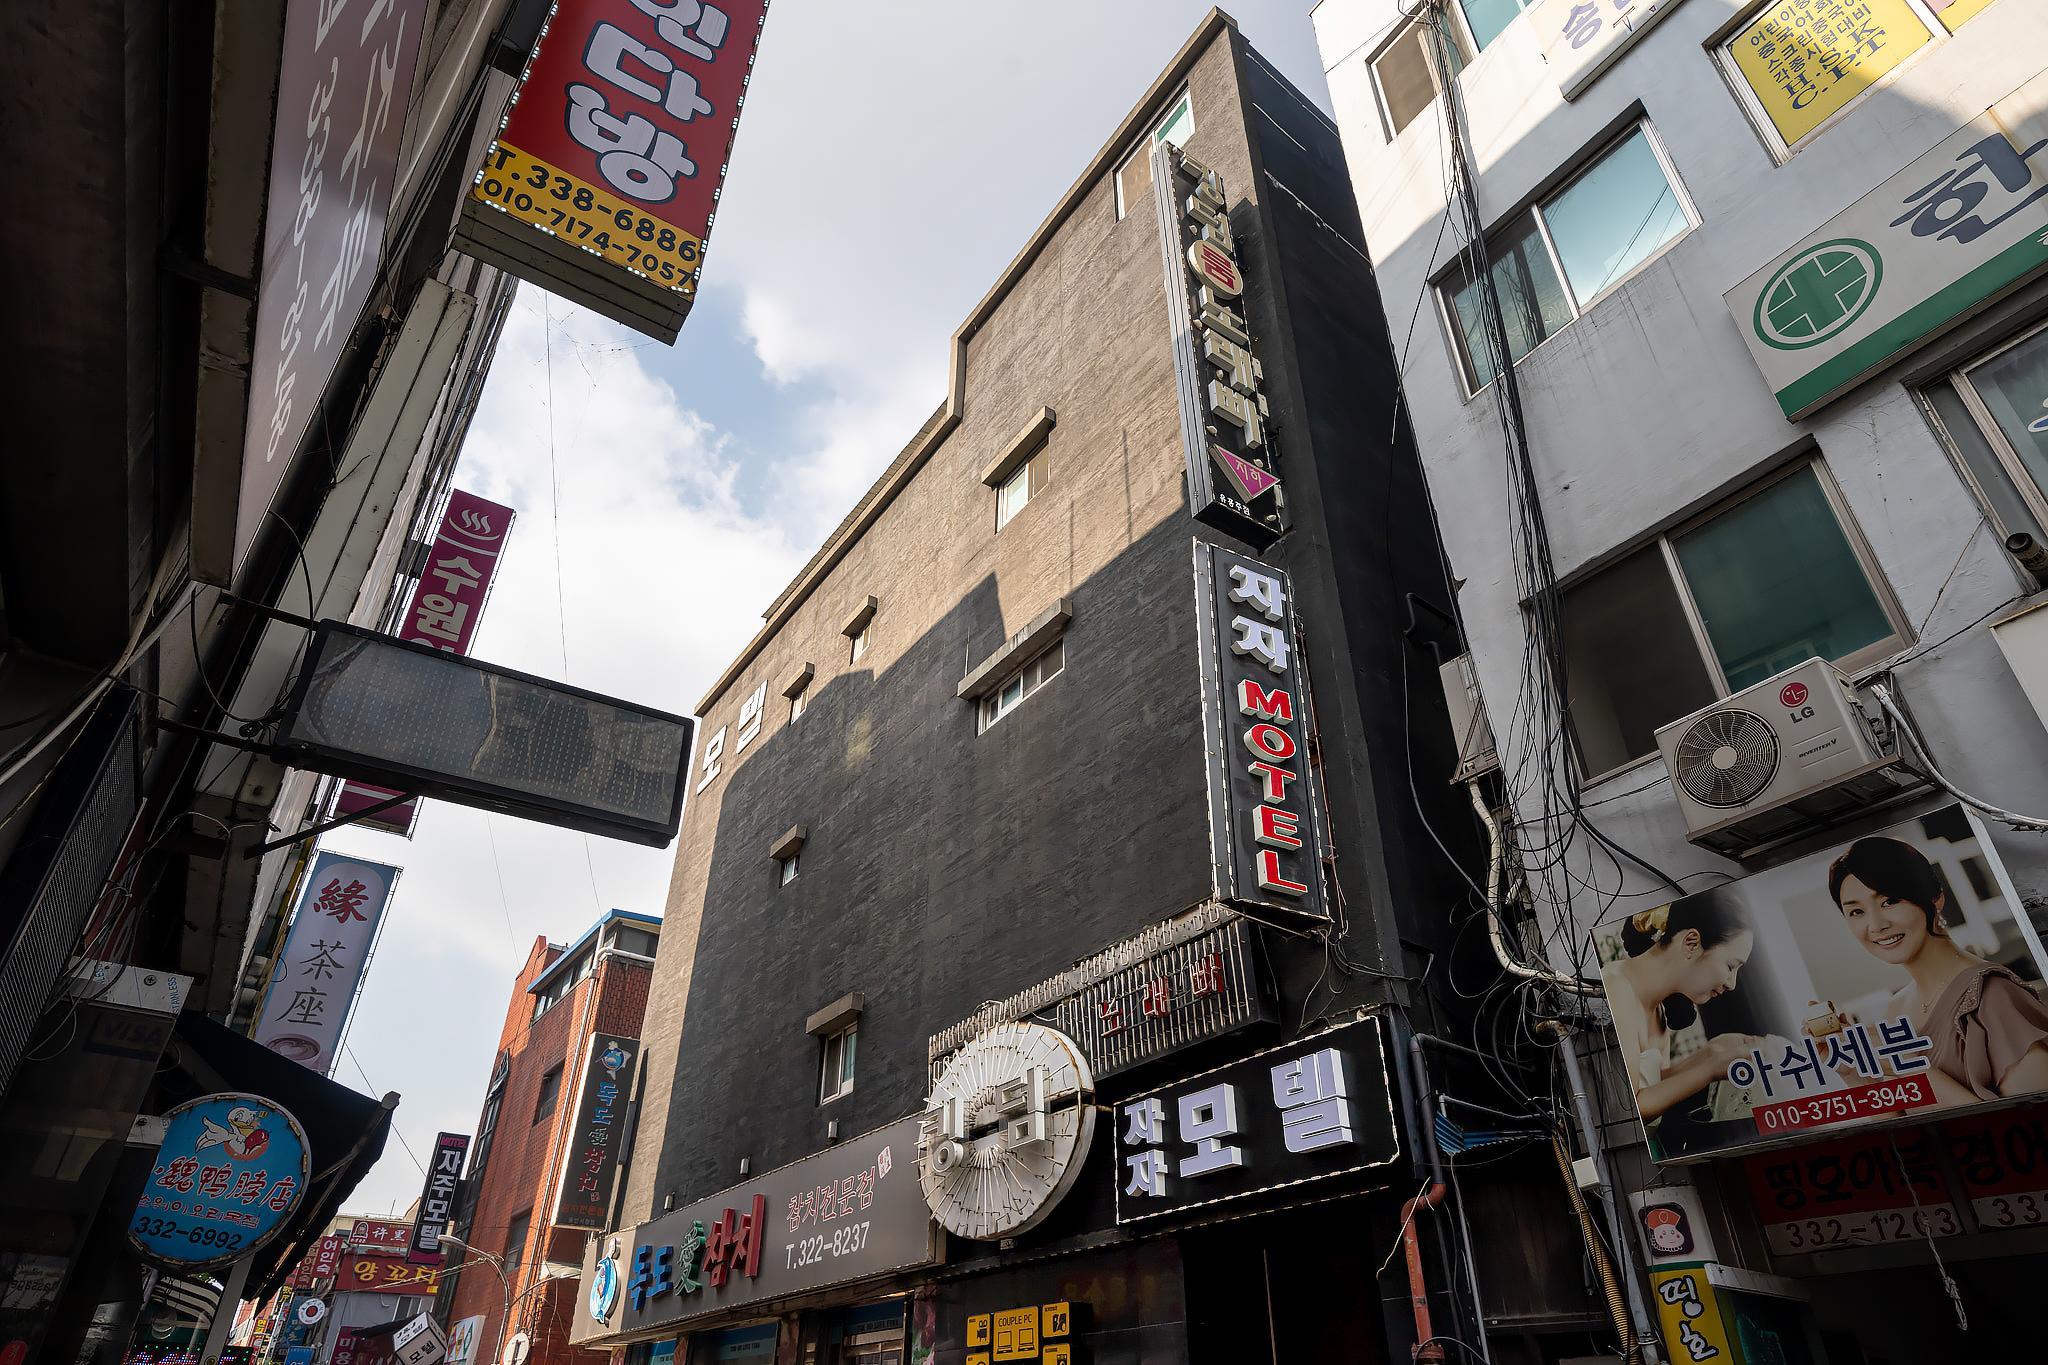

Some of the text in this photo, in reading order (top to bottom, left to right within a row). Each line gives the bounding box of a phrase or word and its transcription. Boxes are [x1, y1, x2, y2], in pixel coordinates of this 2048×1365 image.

[483, 177, 695, 287] 010-7174-7057
[408, 555, 483, 654] 수원
[696, 679, 769, 796] 모텔
[1228, 564, 1308, 896] 자자 MOTEL
[1790, 706, 1815, 724] LG
[1728, 1016, 1931, 1098] 아쉬세븐
[1123, 1097, 1169, 1197] 자자
[1178, 1047, 1355, 1178] 모텔
[1763, 1081, 1923, 1130] 010-3751-3943
[134, 1216, 243, 1251] 332-6992
[418, 1149, 461, 1251] 자주모텔
[785, 1220, 871, 1270] T.322-8237
[409, 1340, 437, 1364] 모텔
[998, 1313, 1033, 1328] COUPLE PC
